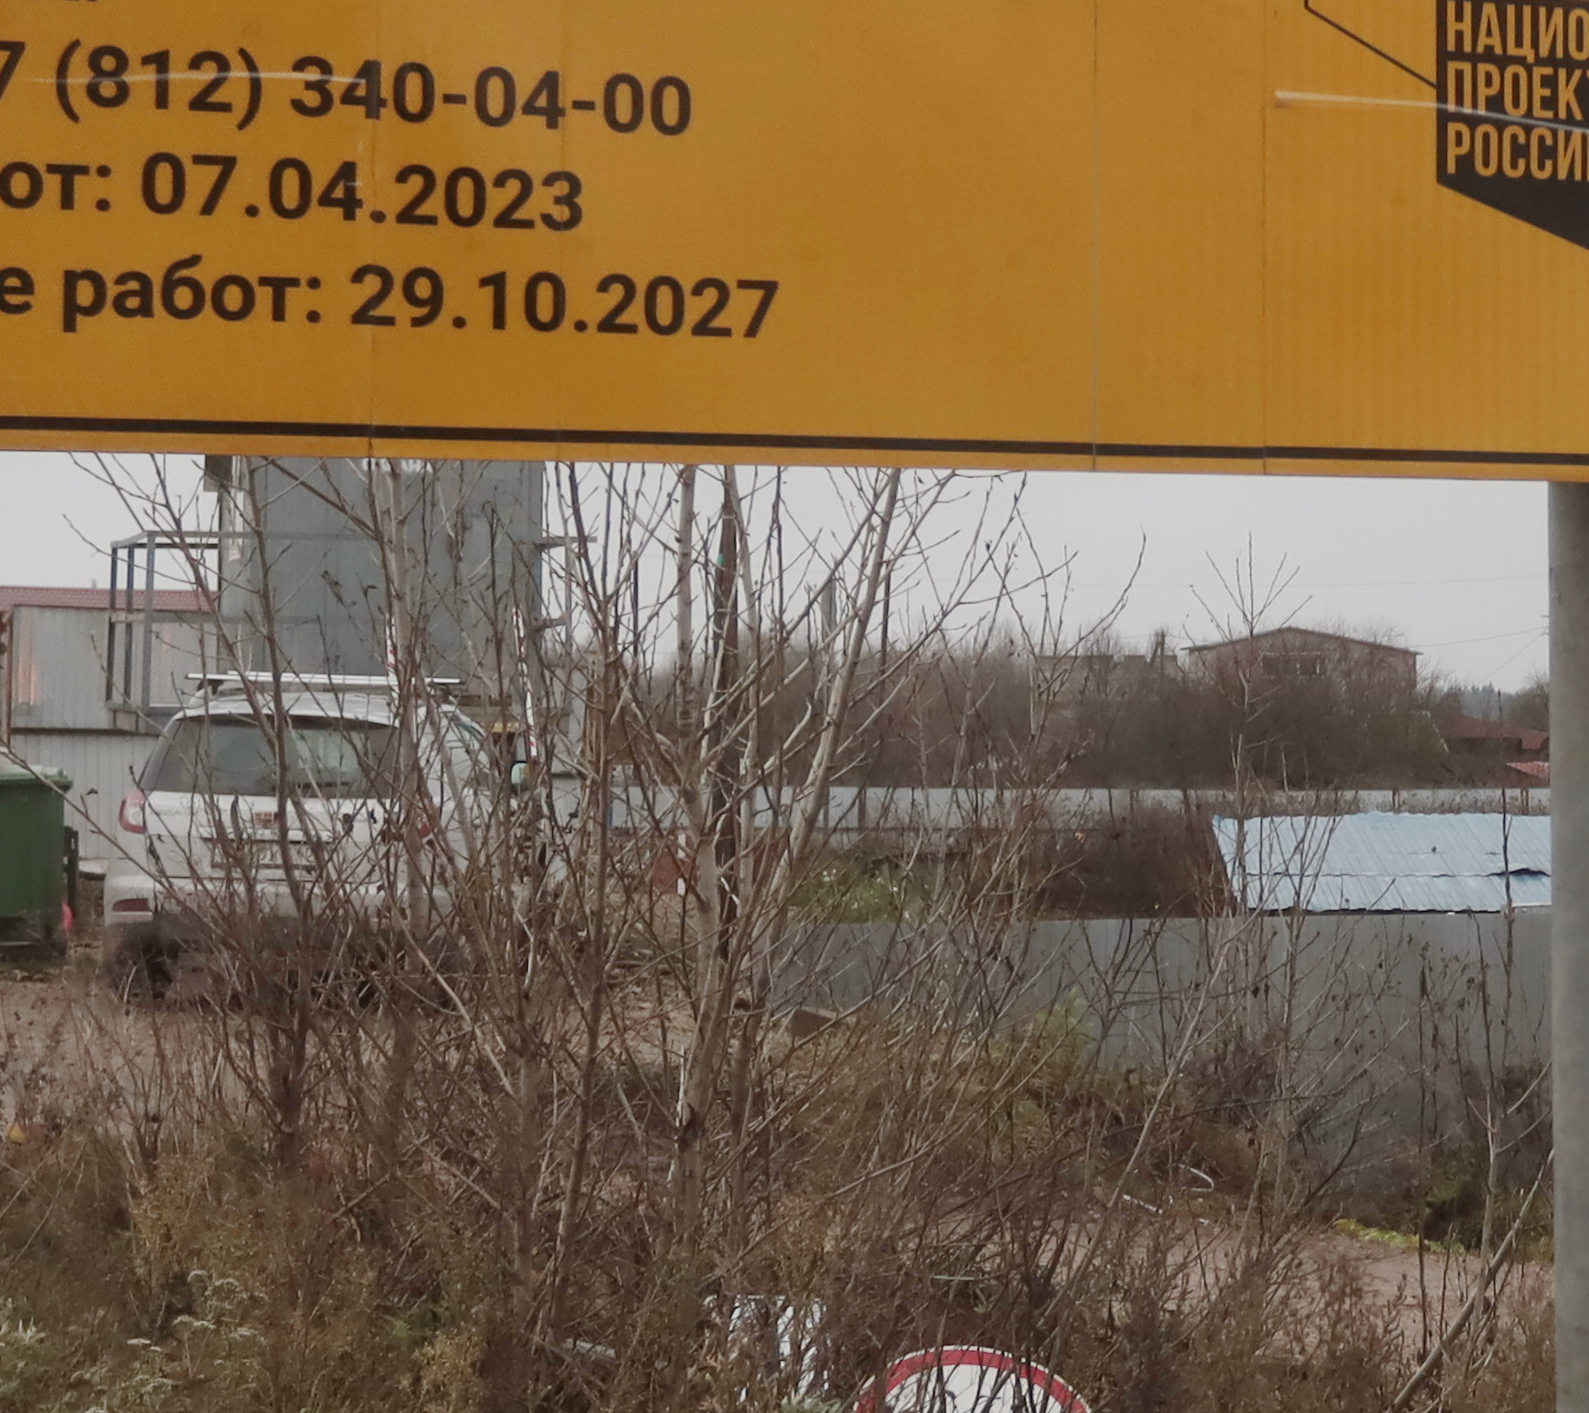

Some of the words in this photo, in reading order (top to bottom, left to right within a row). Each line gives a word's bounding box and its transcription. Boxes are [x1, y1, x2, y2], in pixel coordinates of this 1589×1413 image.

[56, 39, 262, 131] (812)
[290, 56, 691, 136] 340-04-00
[142, 152, 582, 231] 07.04.2023
[63, 254, 321, 333] работ:
[350, 264, 778, 338] 29.10.2027
